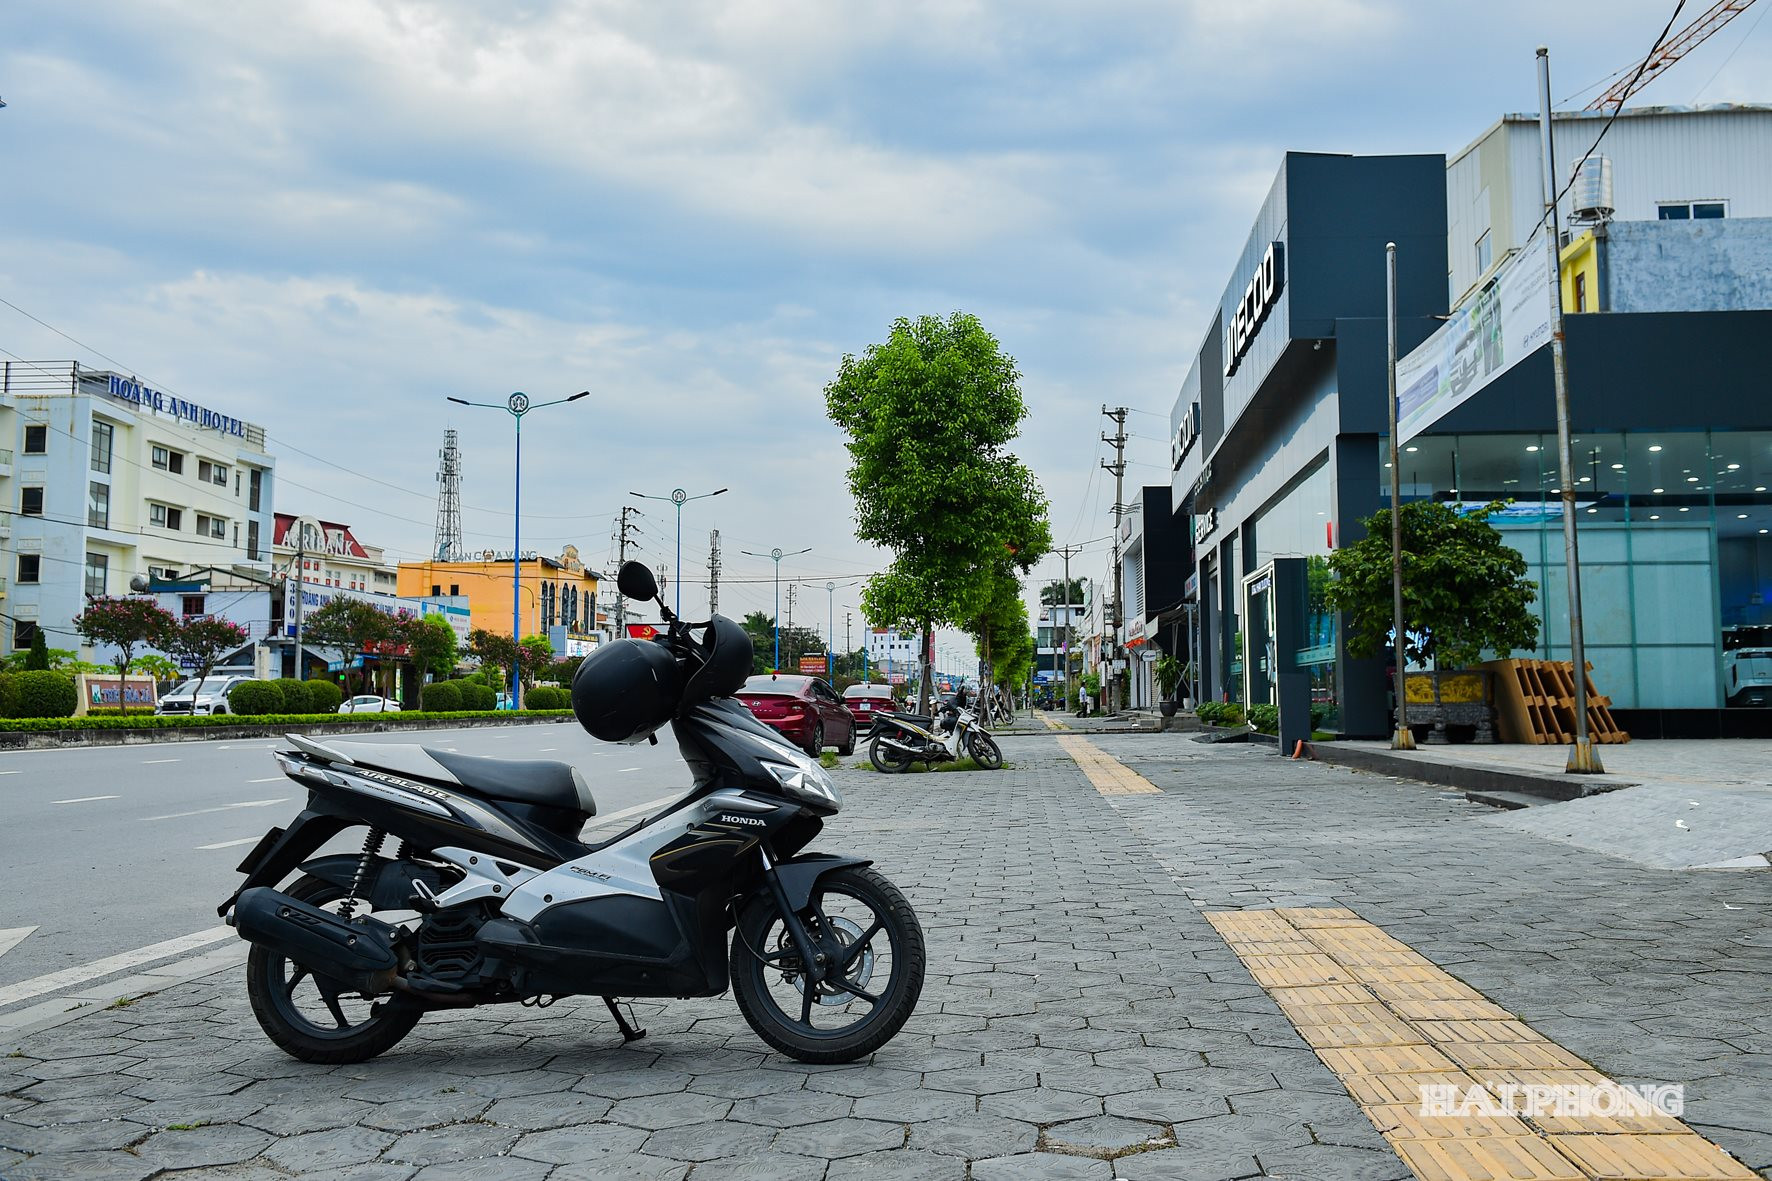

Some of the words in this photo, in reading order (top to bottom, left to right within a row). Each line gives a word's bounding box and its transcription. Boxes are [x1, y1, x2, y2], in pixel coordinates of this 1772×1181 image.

[109, 375, 163, 412] HOÀNG
[169, 397, 198, 423] ANH
[203, 408, 245, 439] HOTEL
[505, 550, 538, 561] VNG
[721, 814, 767, 827] HONDA
